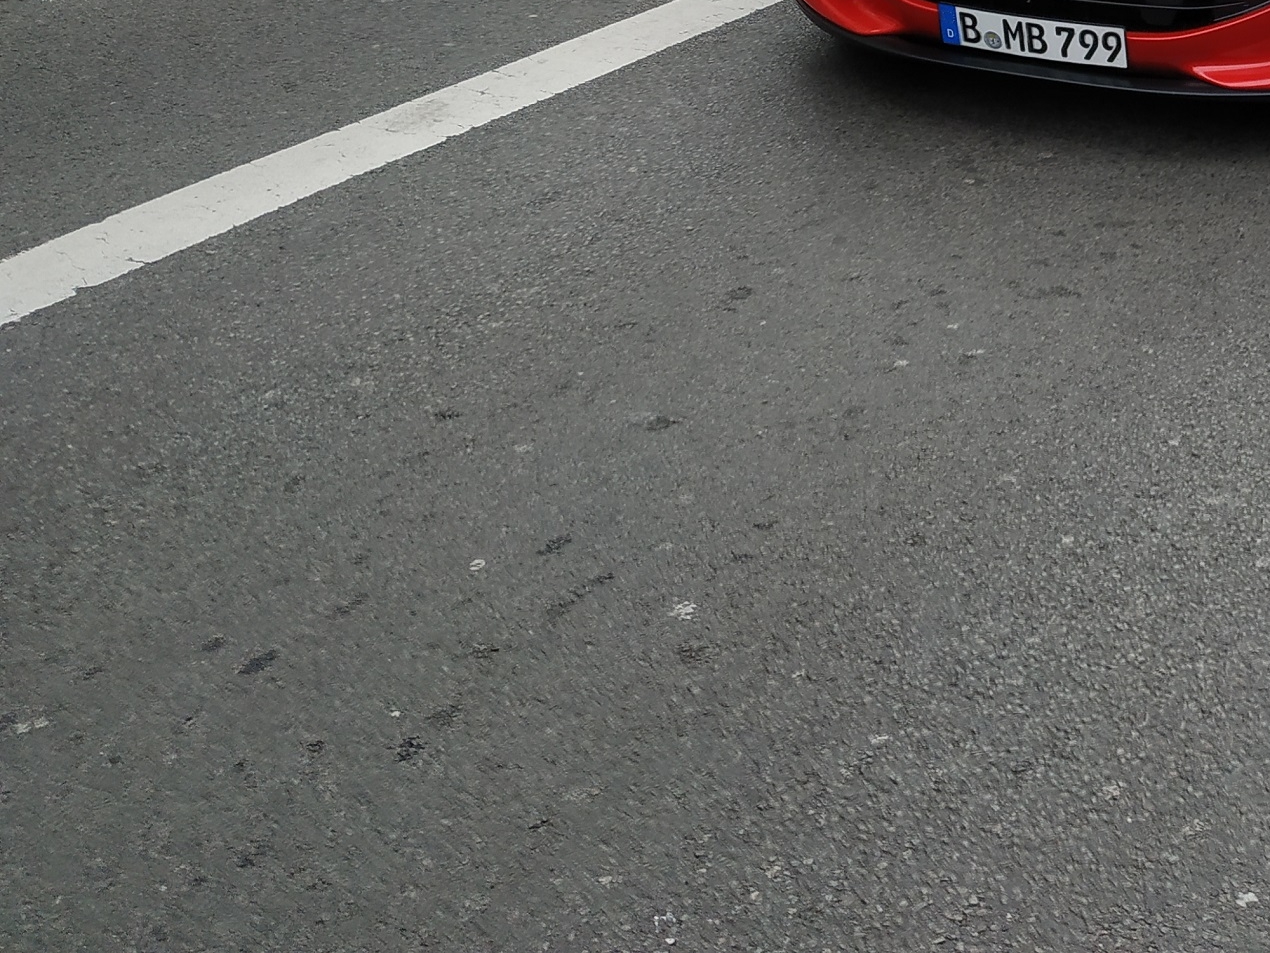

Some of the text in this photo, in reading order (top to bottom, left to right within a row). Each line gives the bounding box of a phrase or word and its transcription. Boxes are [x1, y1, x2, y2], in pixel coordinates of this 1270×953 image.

[947, 11, 1122, 63] D B MB 799
